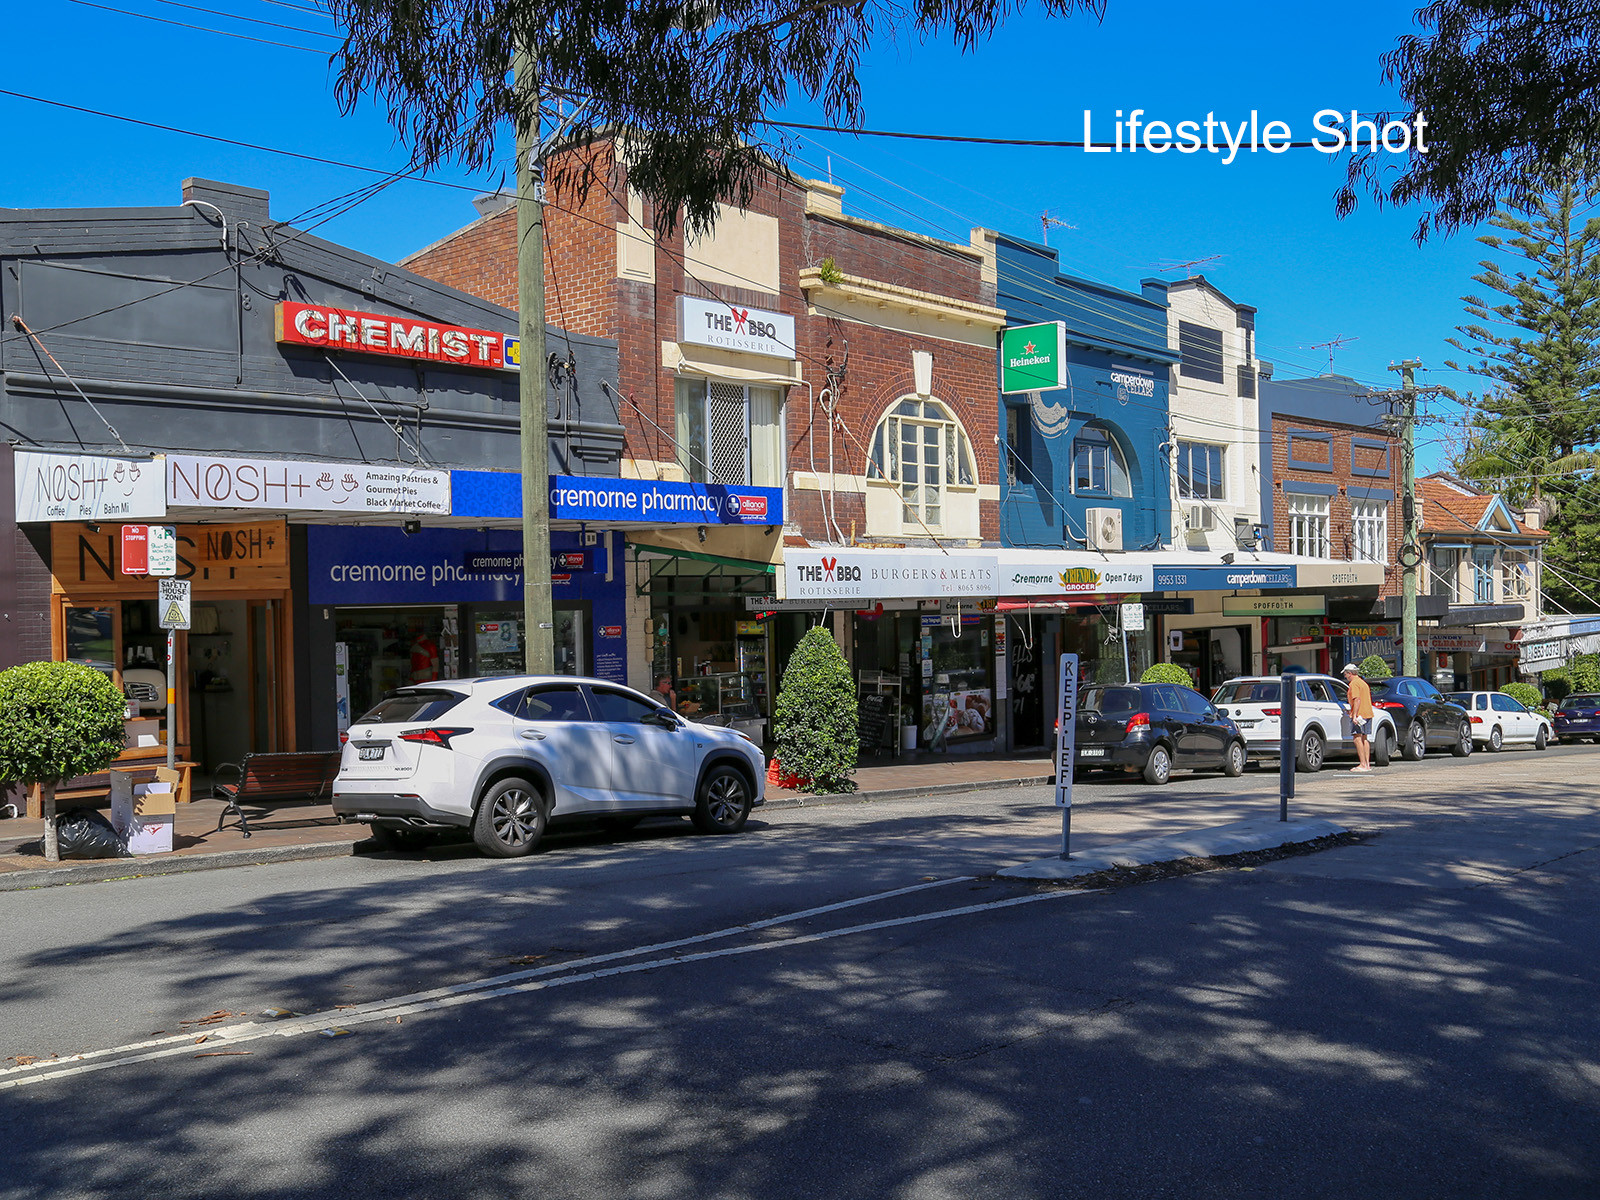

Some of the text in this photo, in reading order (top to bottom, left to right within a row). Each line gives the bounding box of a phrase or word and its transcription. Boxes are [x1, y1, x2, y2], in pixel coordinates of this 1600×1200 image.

[704, 312, 776, 339] THE BBQ
[294, 309, 499, 361] CHEMIST
[707, 334, 776, 353] ROTISSERIE
[1010, 354, 1051, 368] Heineken
[1110, 372, 1154, 389] camperdown
[1126, 384, 1154, 398] CELLARS
[38, 462, 108, 502] NOSH+
[173, 461, 310, 503] NOSH+
[366, 472, 439, 484] Amazing Pastries &
[366, 485, 418, 495] Gourmet Pies
[366, 498, 441, 509] Black Market Coffee
[551, 487, 723, 517] cremorne pharmacy
[47, 503, 130, 516] Coffee Pies Bahn Mi
[472, 556, 512, 568] cremorne
[330, 564, 426, 582] cremorne
[797, 566, 861, 582] THE BBQ
[871, 568, 937, 580] BURGERS
[950, 569, 992, 580] MEATS
[1014, 573, 1053, 584] Cremorne
[1066, 568, 1095, 583] FRIENDLY
[1105, 573, 1143, 584] Open 7 days
[800, 587, 861, 595] ROTISSERIE
[1066, 583, 1095, 591] GROCER
[1349, 628, 1372, 636] THAI
[1063, 661, 1074, 726] KEEP
[1060, 736, 1069, 804] LEFT
